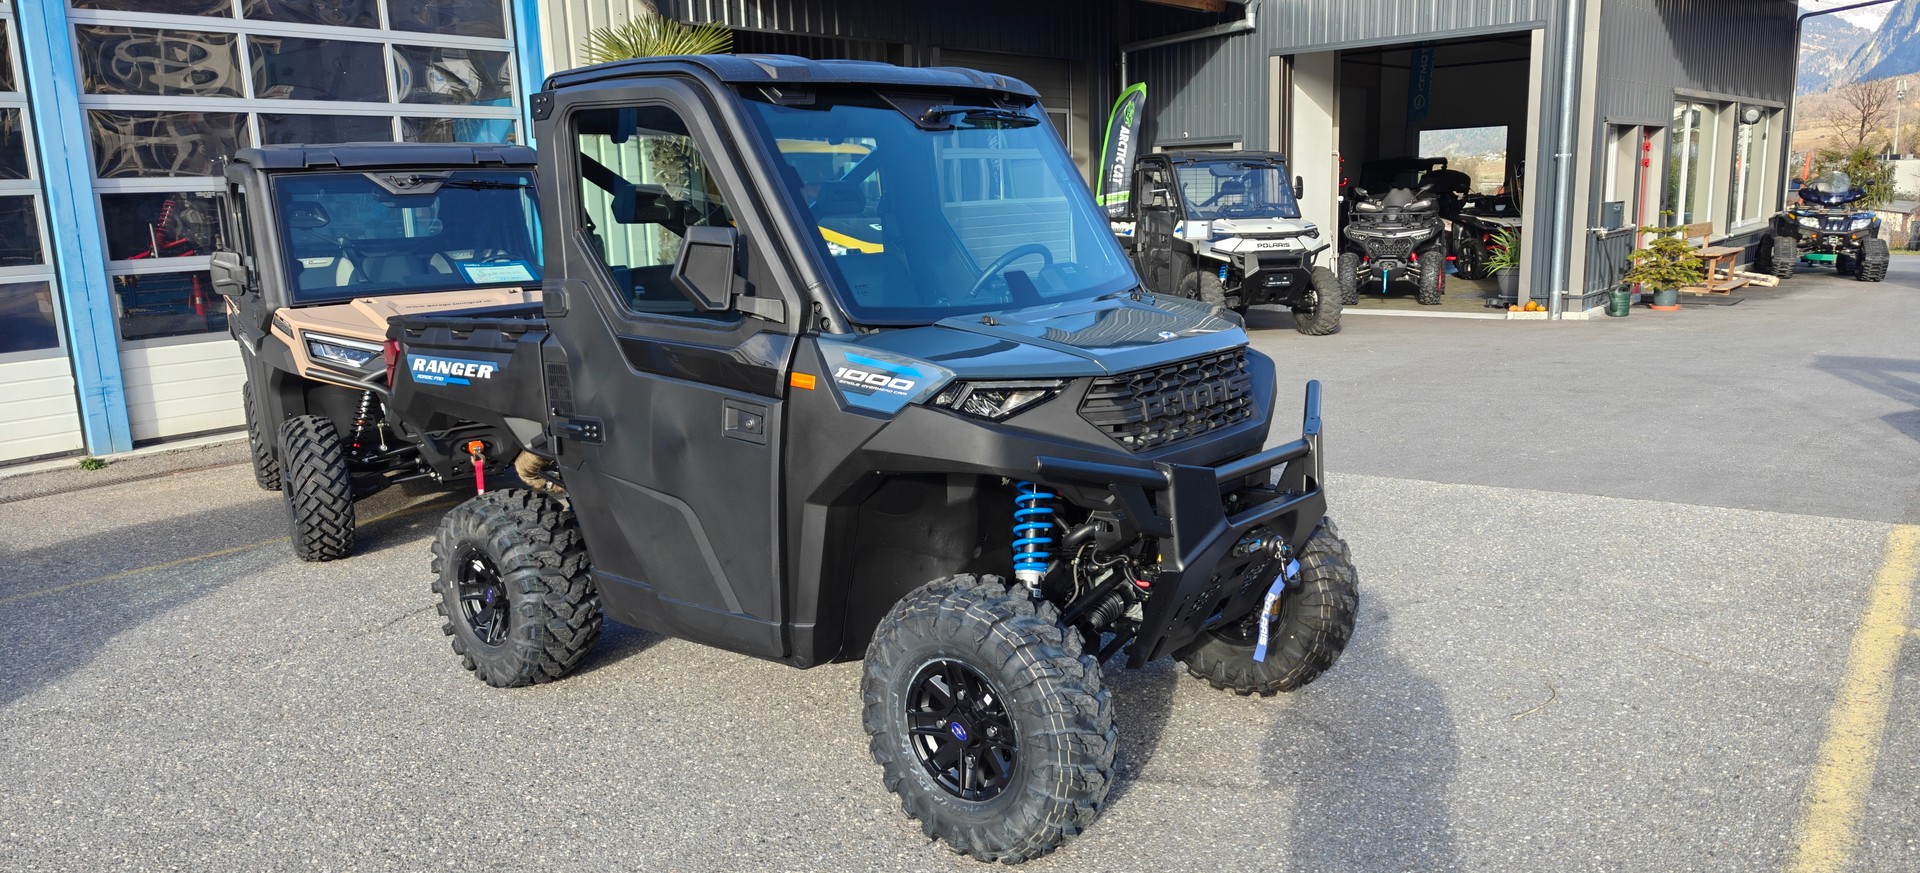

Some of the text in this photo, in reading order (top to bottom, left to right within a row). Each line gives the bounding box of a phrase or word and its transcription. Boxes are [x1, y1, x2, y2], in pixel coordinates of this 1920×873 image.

[1112, 125, 1130, 187] ARCTIC CAT
[412, 358, 494, 379] RANGER
[834, 366, 915, 391] 1000
[838, 379, 860, 387] SINGLE
[861, 384, 893, 394] OVERHEAD
[1142, 373, 1250, 422] POLARIS
[1259, 592, 1276, 646] POLARIS
